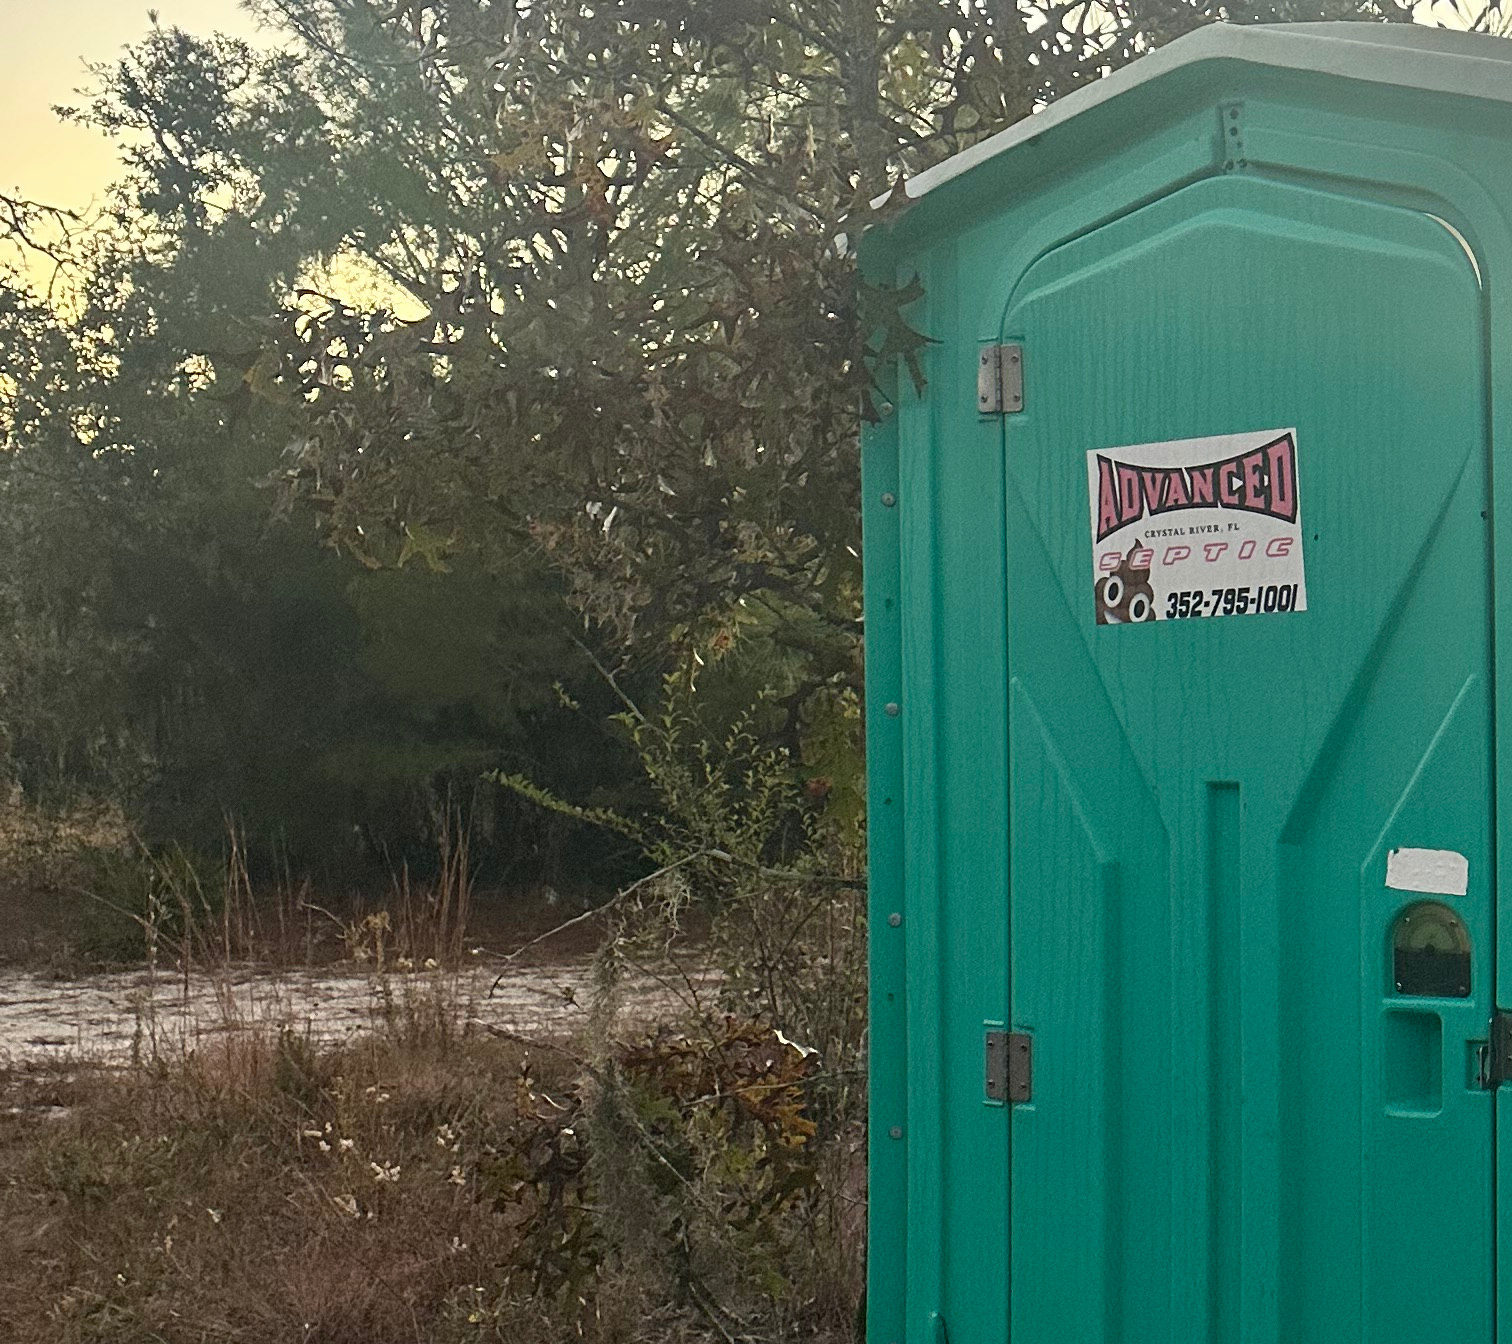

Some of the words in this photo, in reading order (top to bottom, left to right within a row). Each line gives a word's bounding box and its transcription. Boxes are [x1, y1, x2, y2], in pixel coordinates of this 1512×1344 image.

[1097, 432, 1298, 544] ADVANCED
[1144, 527, 1186, 538] CRYSTAL
[1189, 524, 1223, 535] RIVER,
[1227, 523, 1240, 531] FL
[1099, 537, 1294, 571] SEPTIC
[1166, 584, 1298, 619] 352-795-1001
